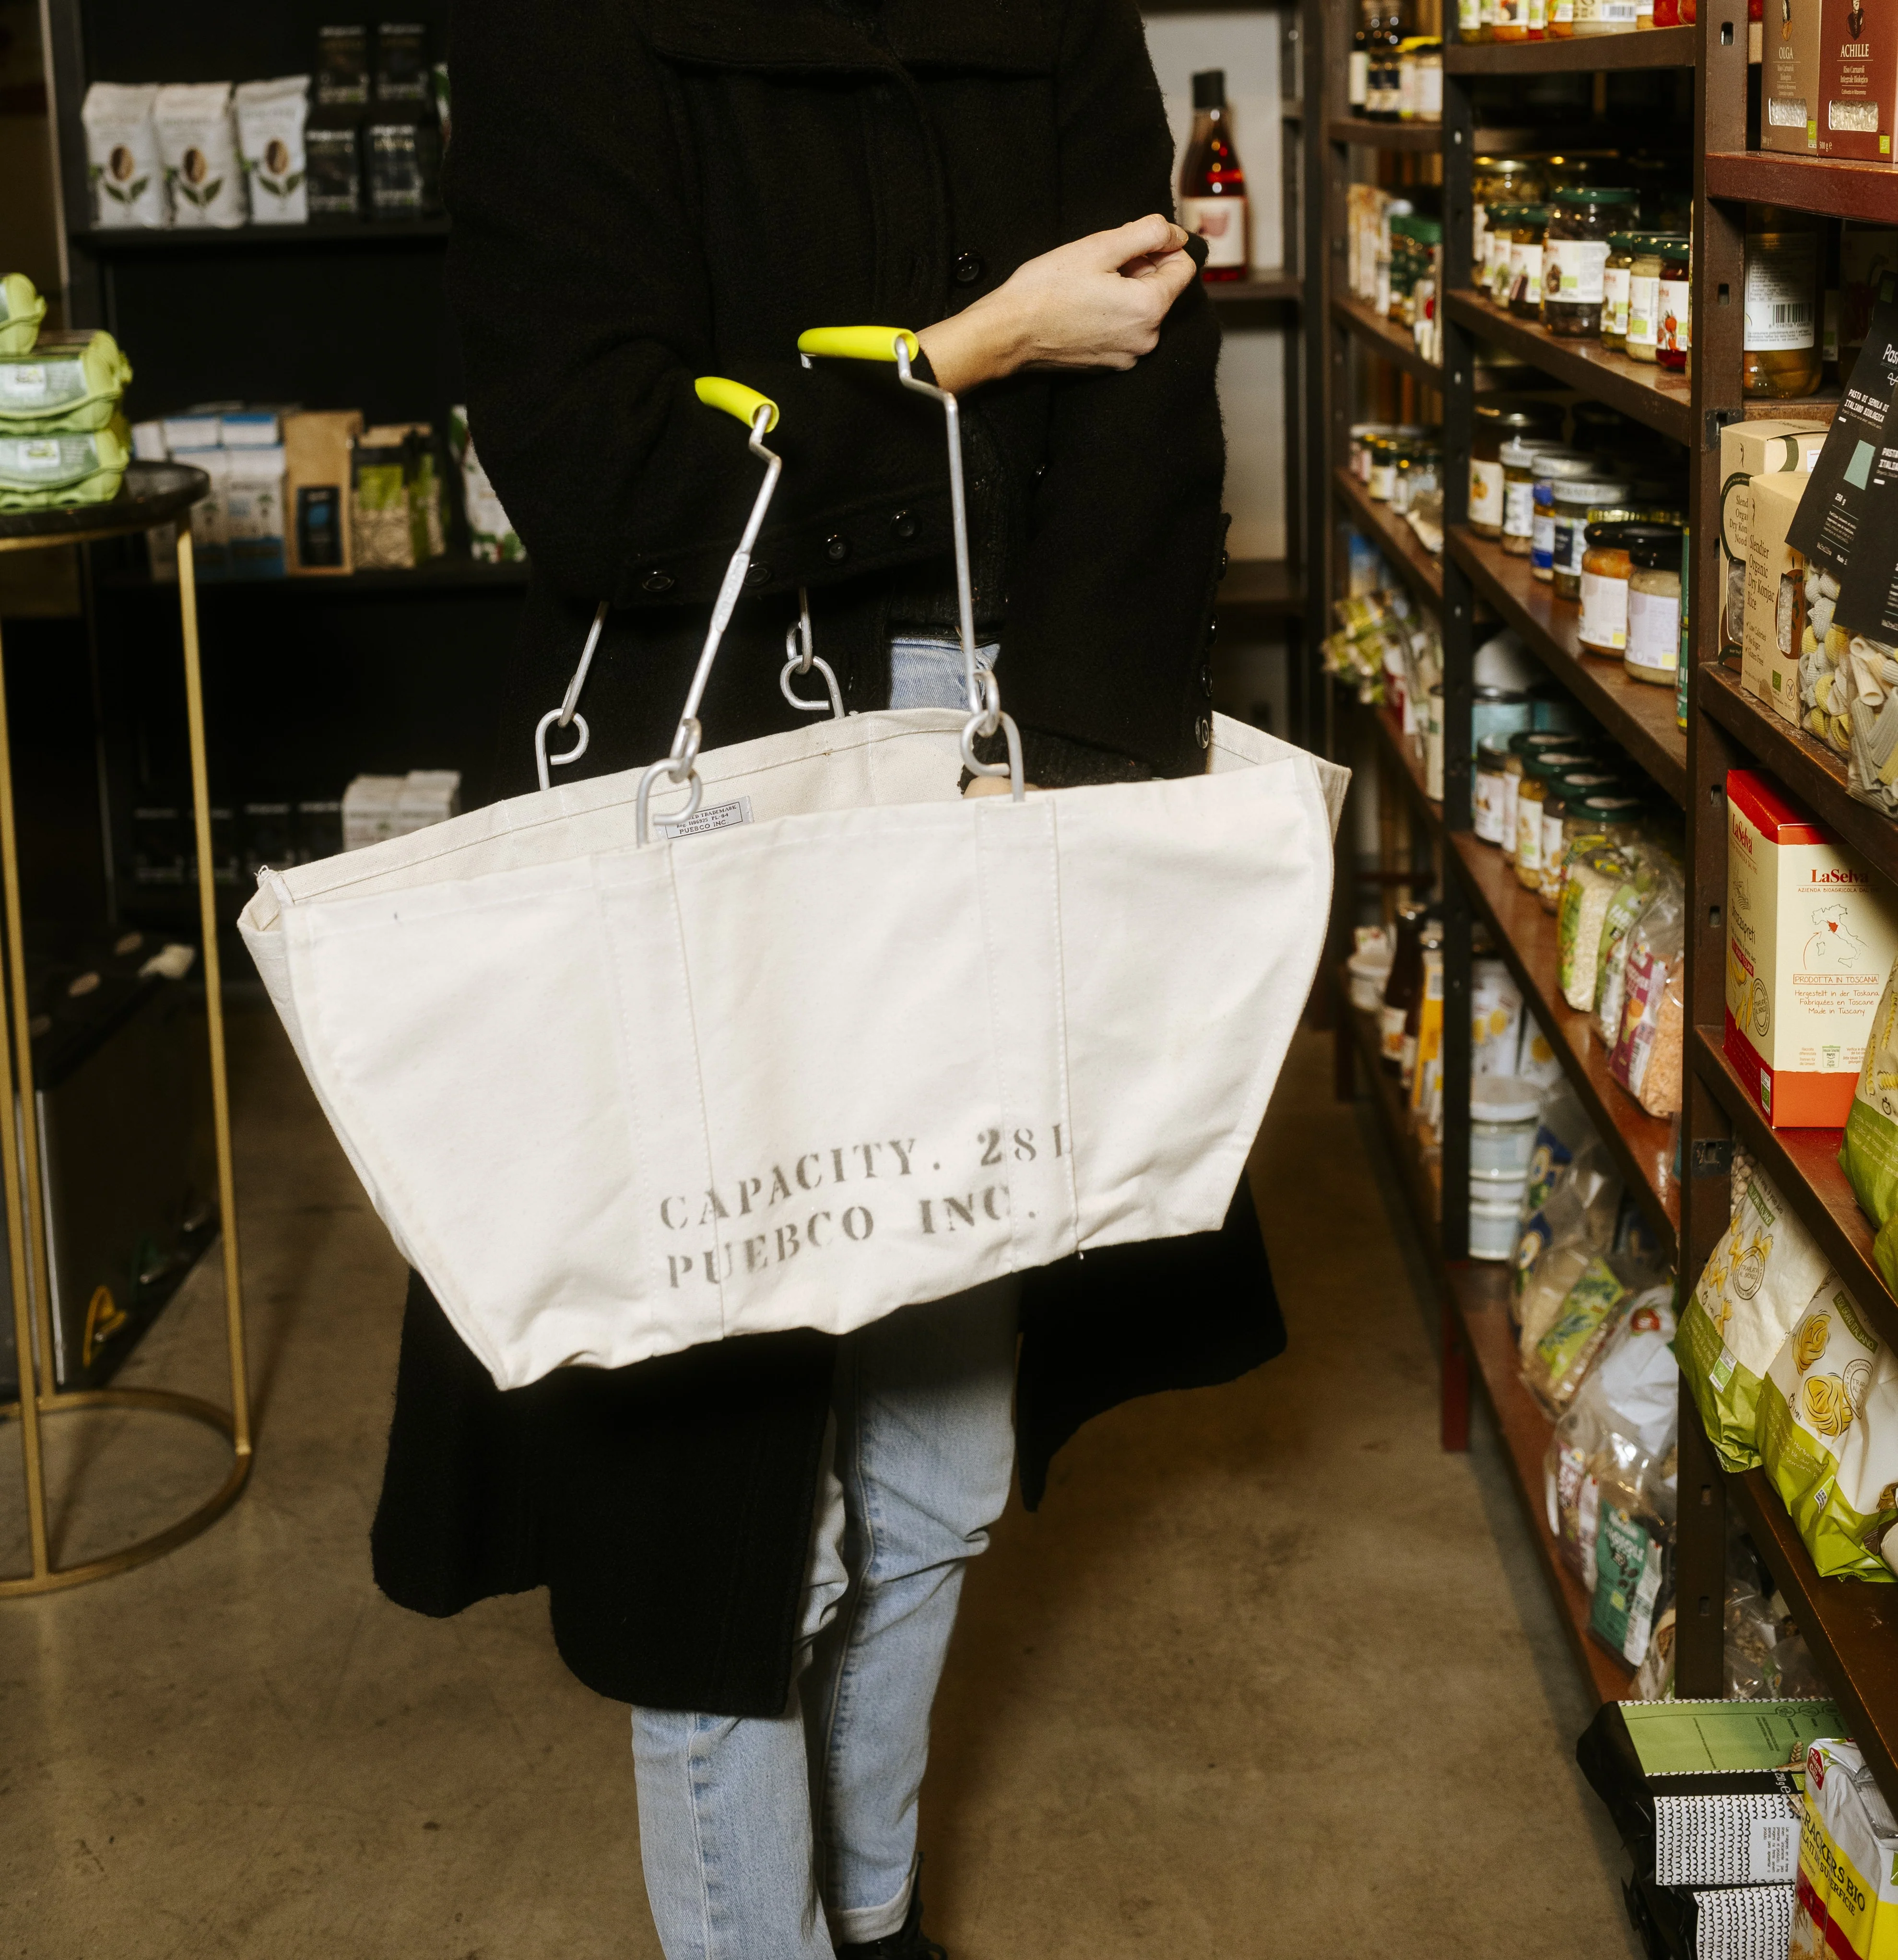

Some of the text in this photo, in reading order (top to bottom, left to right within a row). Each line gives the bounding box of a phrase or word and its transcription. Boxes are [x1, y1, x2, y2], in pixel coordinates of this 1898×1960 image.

[1779, 47, 1793, 59] OLGA
[1840, 44, 1869, 57] ACHILLE
[1826, 143, 1829, 152] g
[1848, 389, 1862, 401] PASTA
[1862, 394, 1868, 403] DI
[1882, 403, 1889, 413] DI
[1844, 399, 1885, 423] ITALIANO BIOLOGICA
[1736, 495, 1748, 508] Slend
[1739, 522, 1747, 533] Kon
[1735, 533, 1747, 546] Nood
[1750, 535, 1769, 559] Slendier
[1749, 554, 1768, 578] Organic
[1748, 573, 1775, 603] Dry Konjac
[1747, 591, 1757, 610] Rice
[1755, 626, 1766, 641] Calories
[1748, 636, 1760, 651] No Sugar
[1748, 648, 1757, 661] Gluten
[701, 805, 737, 818] TRADEMARK
[679, 824, 710, 834] PUEBCO
[1733, 813, 1752, 855] LaSelva
[1811, 869, 1869, 883] LaSelva
[1795, 990, 1827, 999] Hergestellt
[1800, 998, 1834, 1007] Fabriquées
[1839, 1008, 1865, 1016] Tuscany
[660, 1138, 941, 1230] CAPACITY.
[667, 1185, 1037, 1288] PUEBCO INC.
[1842, 1306, 1855, 1326] GRANO
[1850, 1321, 1874, 1349] ITALIANO
[1810, 1749, 1823, 1777] FINESTRA
[1775, 1773, 1786, 1783] 250
[1809, 1763, 1819, 1783] CIELO
[1803, 1809, 1845, 1884] RACKERS
[1846, 1876, 1865, 1912] BIO
